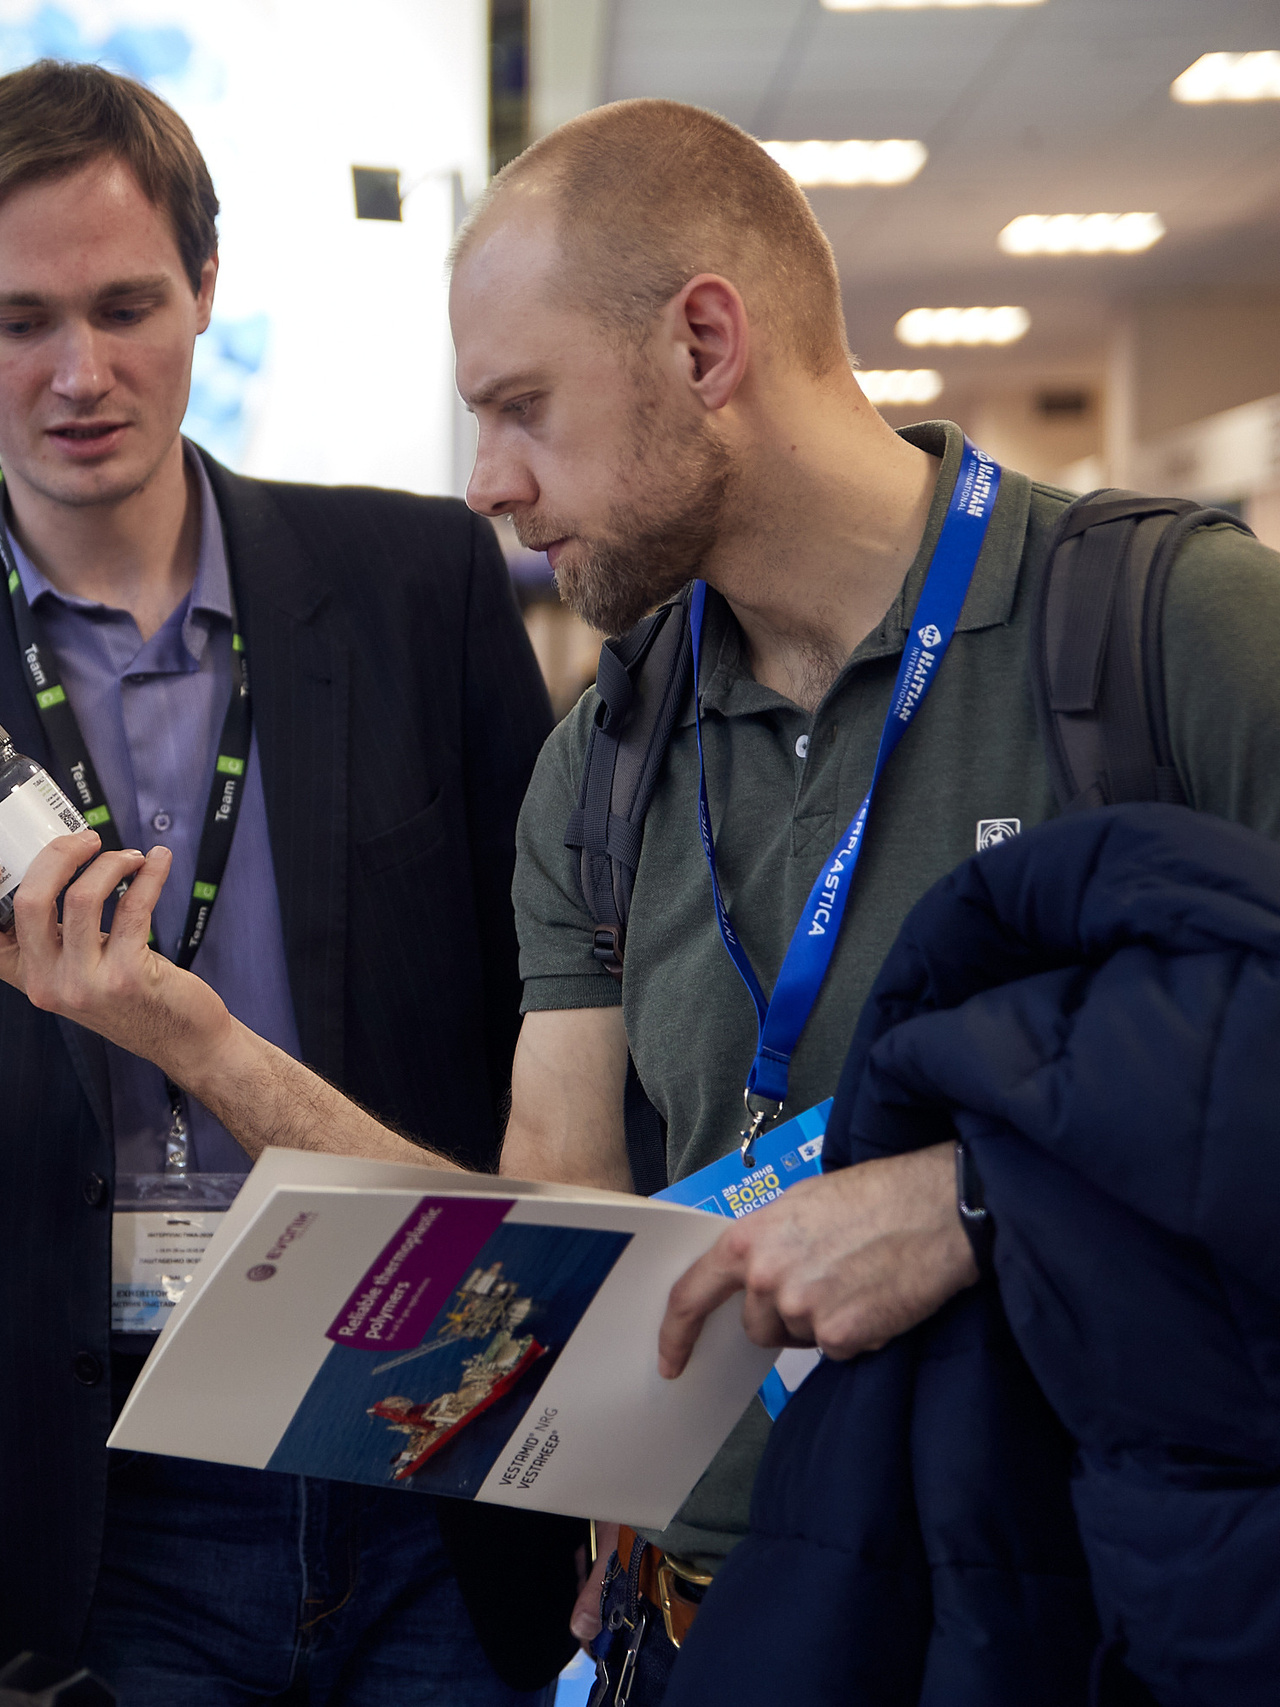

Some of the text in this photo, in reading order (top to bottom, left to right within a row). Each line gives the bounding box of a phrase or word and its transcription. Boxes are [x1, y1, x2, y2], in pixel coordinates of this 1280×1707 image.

[957, 459, 977, 512] INTERNATIONAL
[967, 462, 994, 518] HAITIAN
[24, 643, 47, 686] Team
[892, 647, 920, 716] INTERNATIONAL
[898, 650, 936, 722] HAITIAN
[70, 761, 92, 805] Team
[215, 779, 236, 822] Team
[808, 799, 869, 936] ERPLASTICA
[189, 905, 208, 948] Team
[726, 1173, 780, 1211] 2020
[751, 1164, 775, 1183] ЯНВ
[733, 1187, 786, 1220] МОСКВА
[338, 1206, 444, 1337] Reliable thermoplastic
[364, 1281, 411, 1341] polymers
[534, 1407, 558, 1432] NRG
